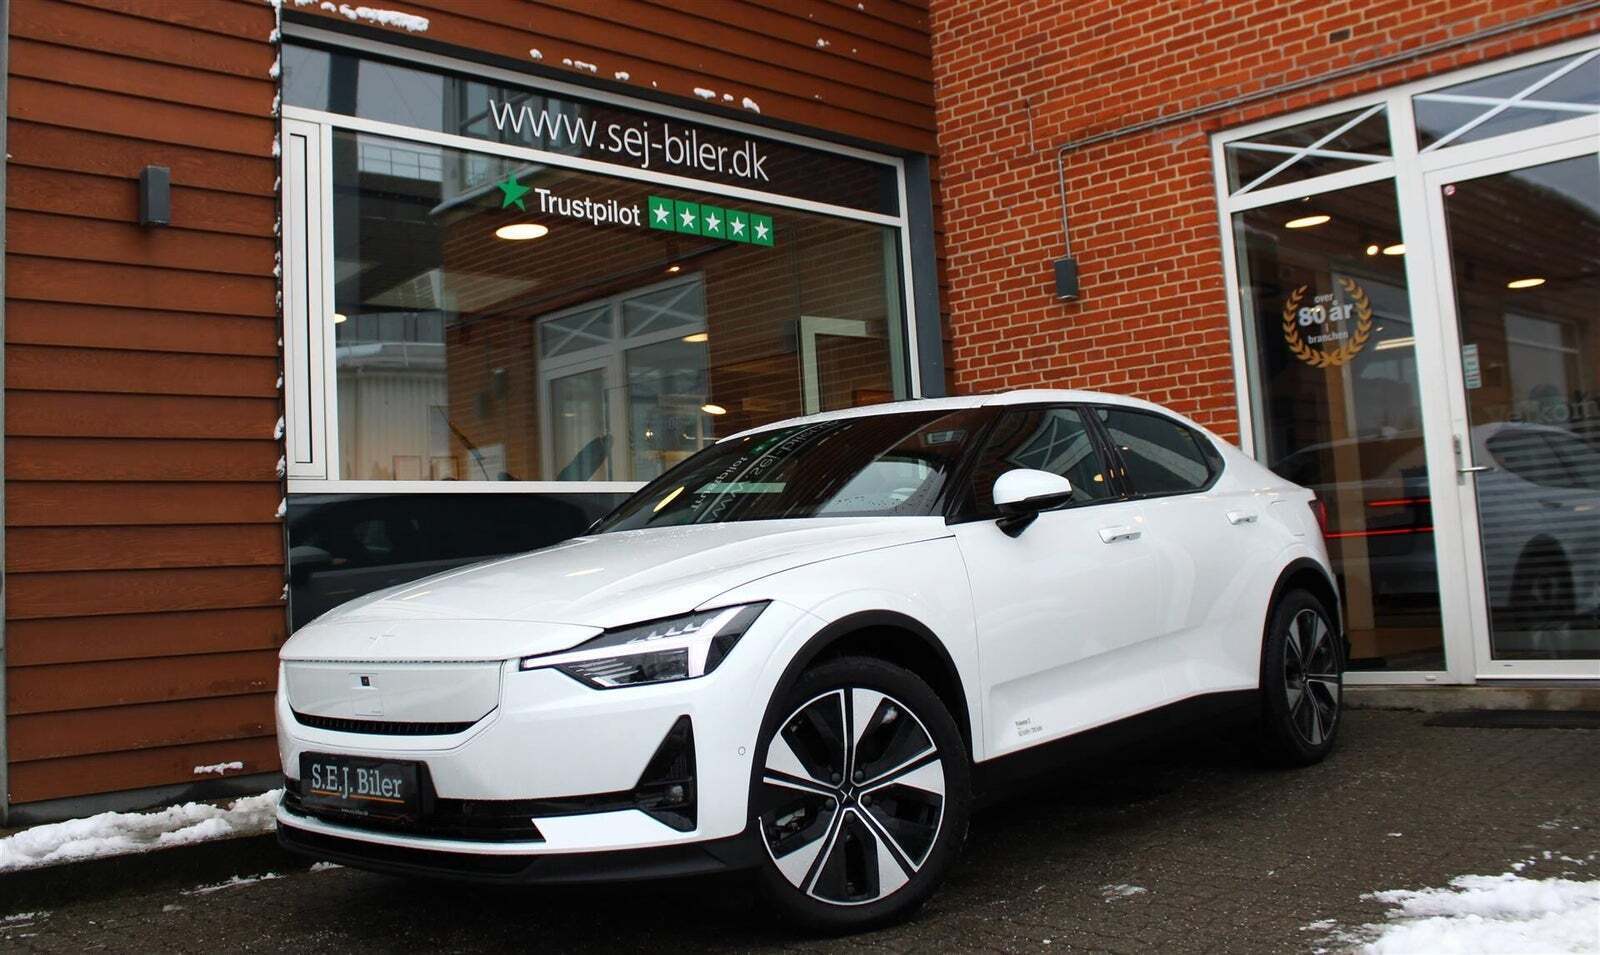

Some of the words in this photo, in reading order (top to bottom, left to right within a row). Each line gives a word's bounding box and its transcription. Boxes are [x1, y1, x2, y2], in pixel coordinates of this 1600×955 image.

[489, 99, 770, 182] www.sej-biler.dk
[534, 187, 641, 226] Trustpilot
[1298, 305, 1326, 326] 80
[1329, 300, 1353, 321] år
[1314, 294, 1333, 303] over
[311, 763, 353, 799] S.E.J.
[357, 767, 402, 798] Biler
